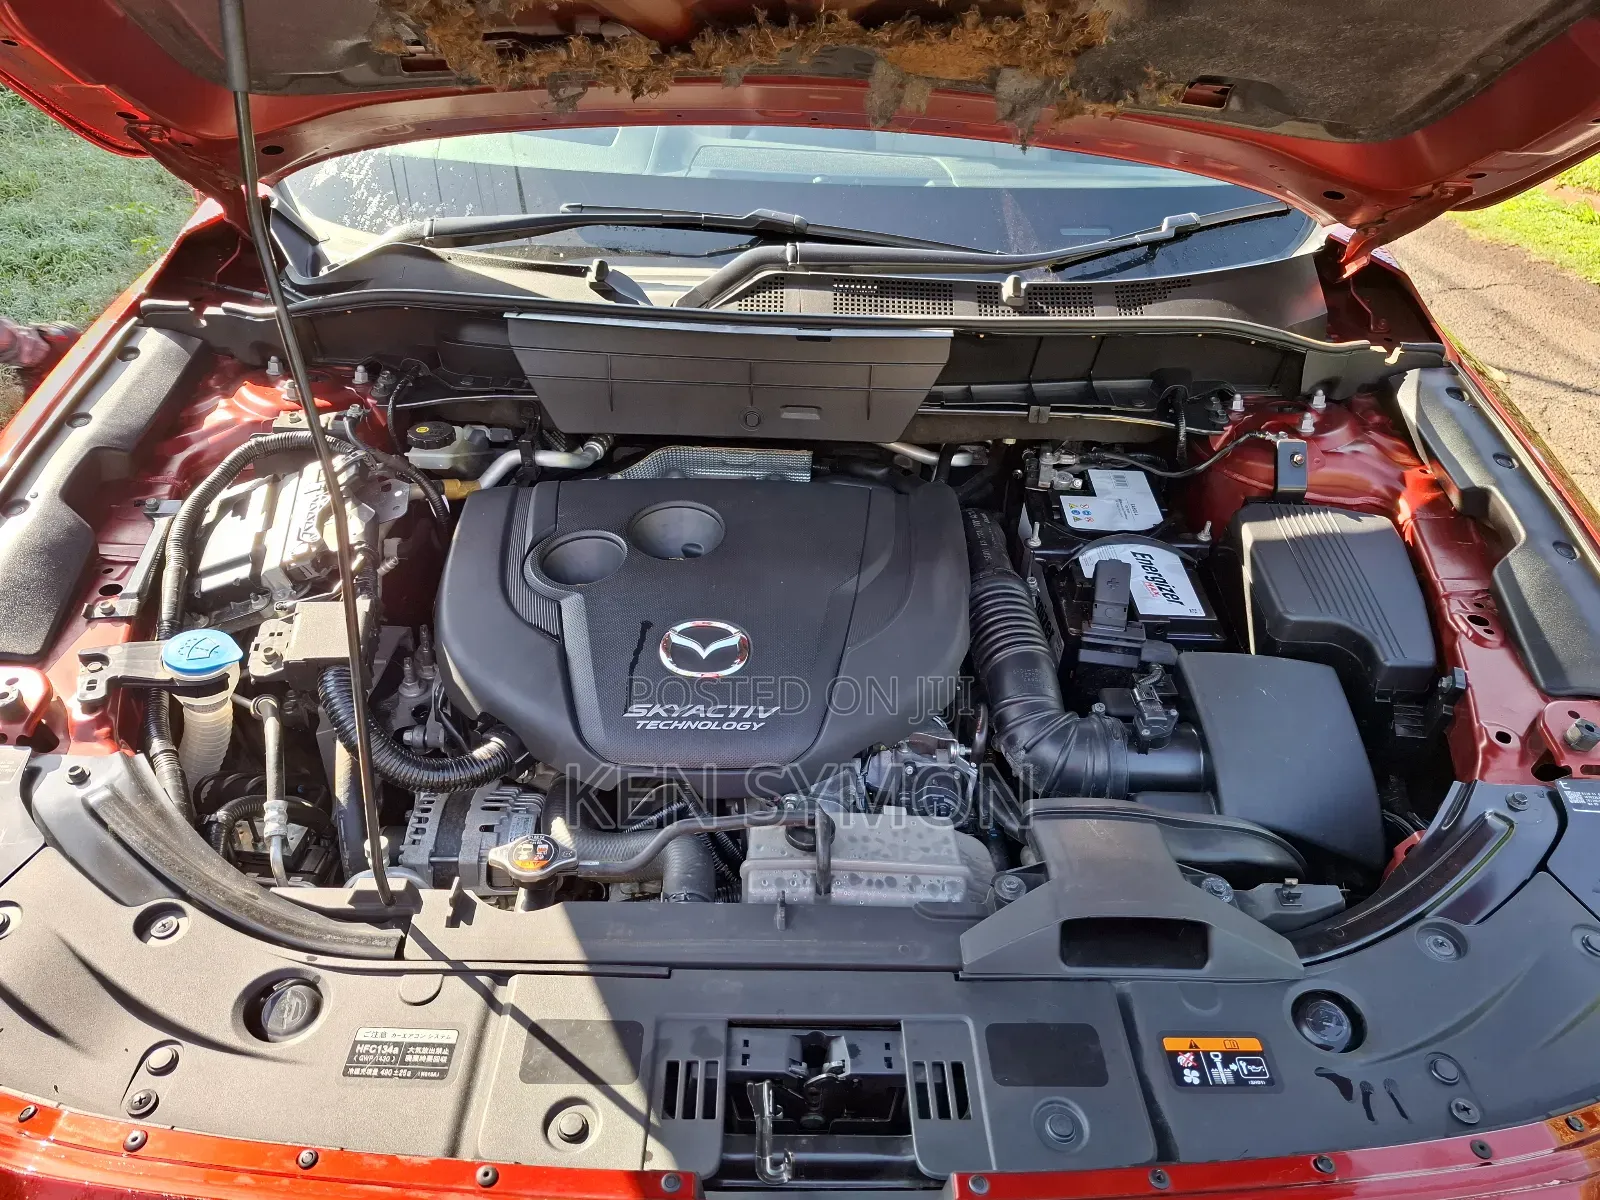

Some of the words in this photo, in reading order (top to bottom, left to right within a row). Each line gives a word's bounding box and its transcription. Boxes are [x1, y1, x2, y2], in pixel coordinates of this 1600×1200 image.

[1130, 551, 1185, 606] Energizer
[1144, 582, 1161, 597] MAX
[623, 704, 781, 719] SKYACTIV
[636, 720, 765, 731] TECHNOLOGY
[363, 1031, 387, 1039] ご注意
[355, 1043, 399, 1055] HFC134a
